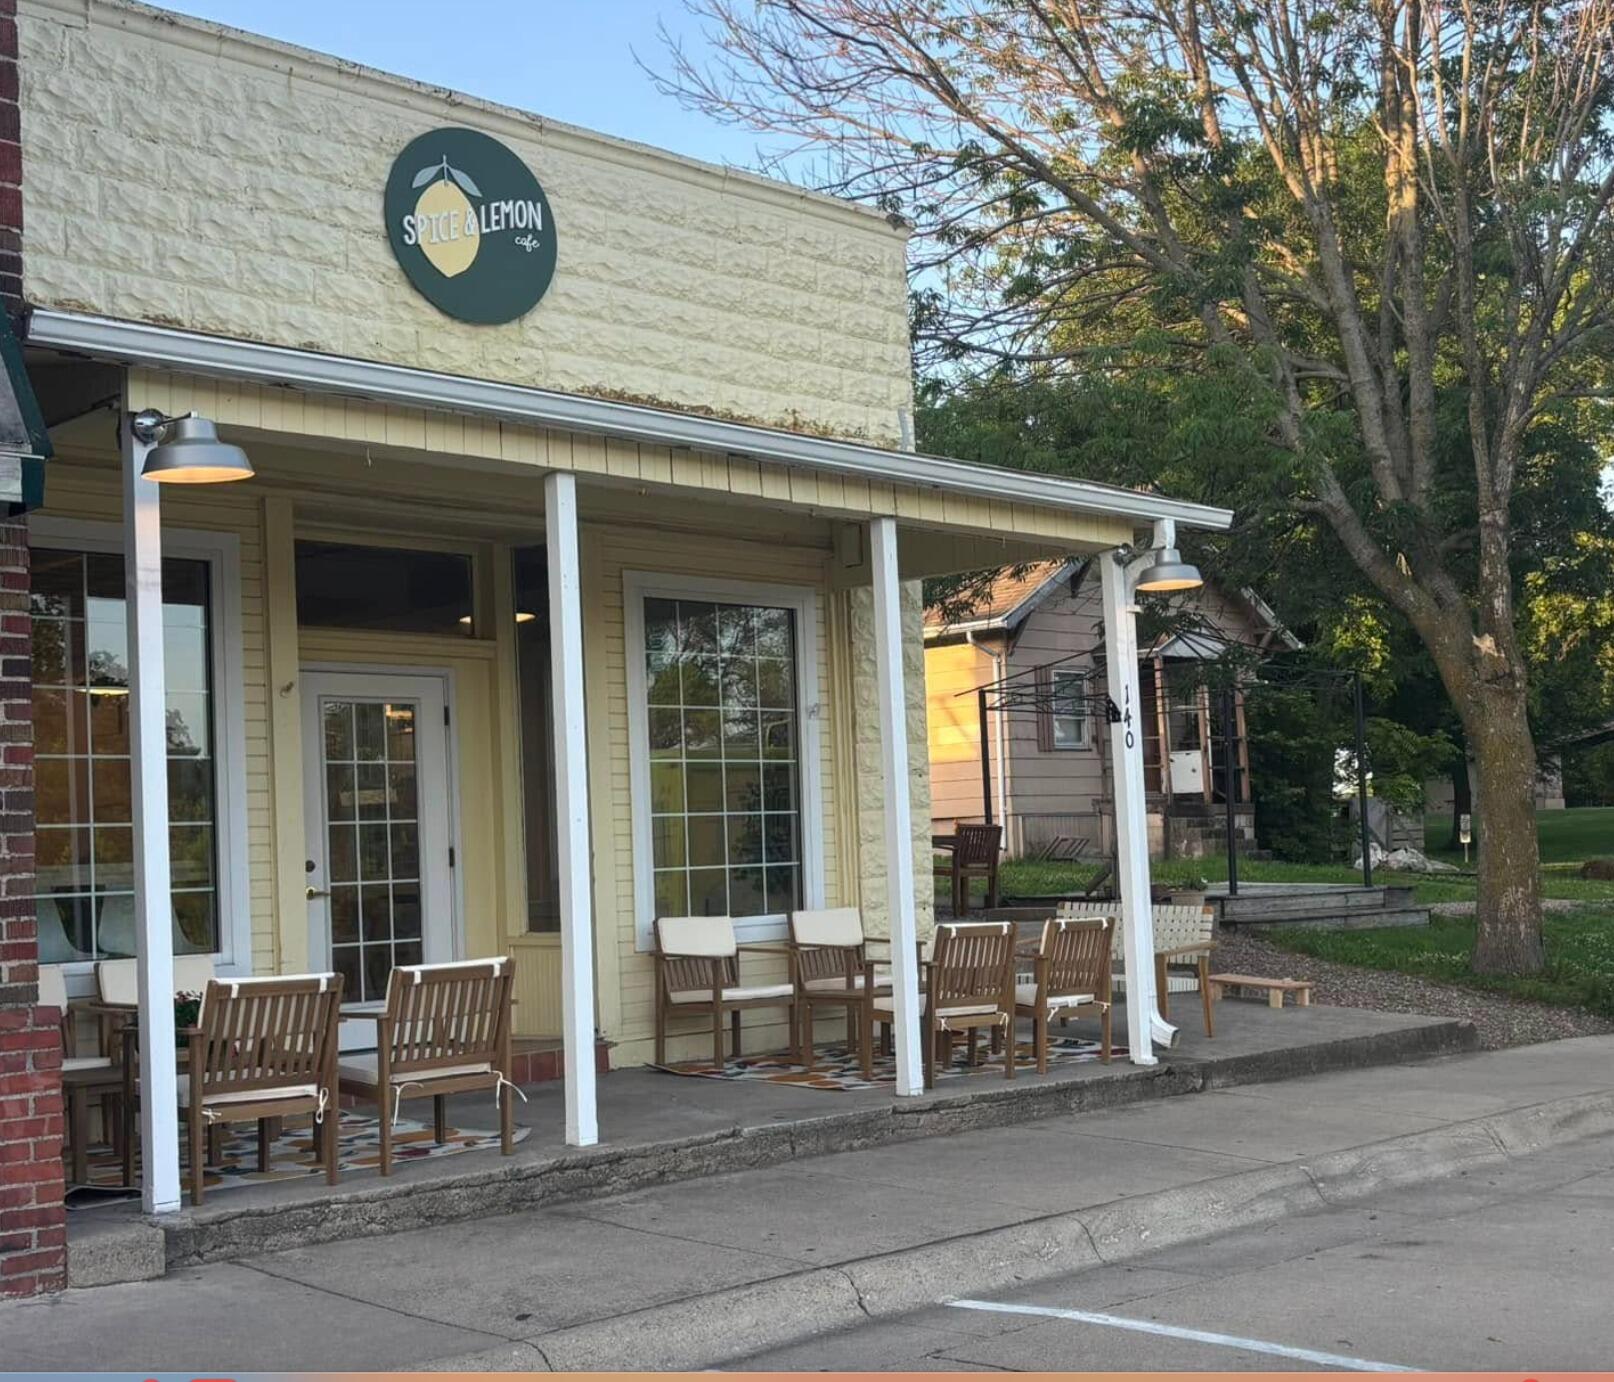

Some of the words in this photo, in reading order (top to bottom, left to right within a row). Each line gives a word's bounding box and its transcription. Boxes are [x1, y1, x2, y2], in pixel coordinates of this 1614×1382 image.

[403, 211, 459, 246] SPICE
[464, 207, 479, 236] &
[481, 200, 543, 234] LEMON
[515, 233, 540, 252] cafe
[1124, 684, 1134, 749] 140
